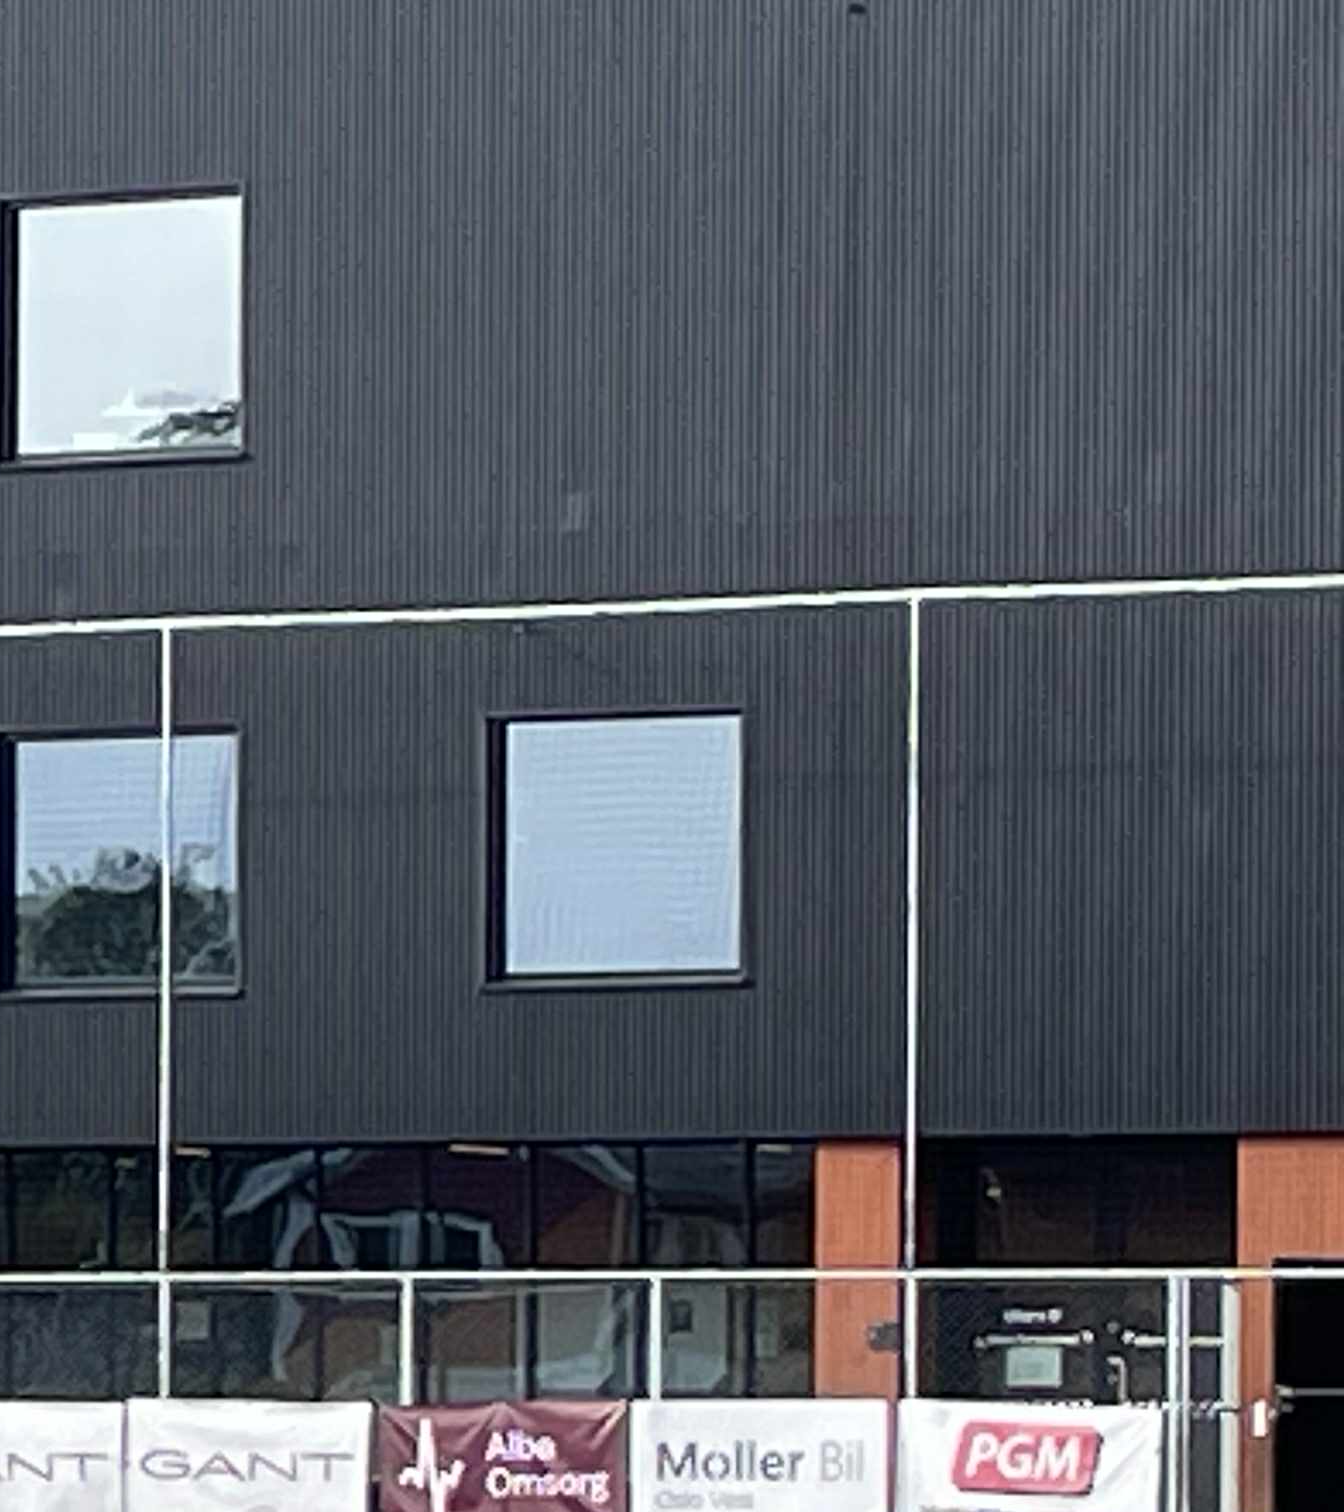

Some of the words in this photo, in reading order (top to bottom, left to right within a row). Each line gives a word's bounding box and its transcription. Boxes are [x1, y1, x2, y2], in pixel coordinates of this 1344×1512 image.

[140, 1449, 356, 1481] GANT
[819, 1439, 865, 1482] Bil
[964, 1431, 1081, 1482] PGM
[484, 1465, 611, 1504] Omsorg
